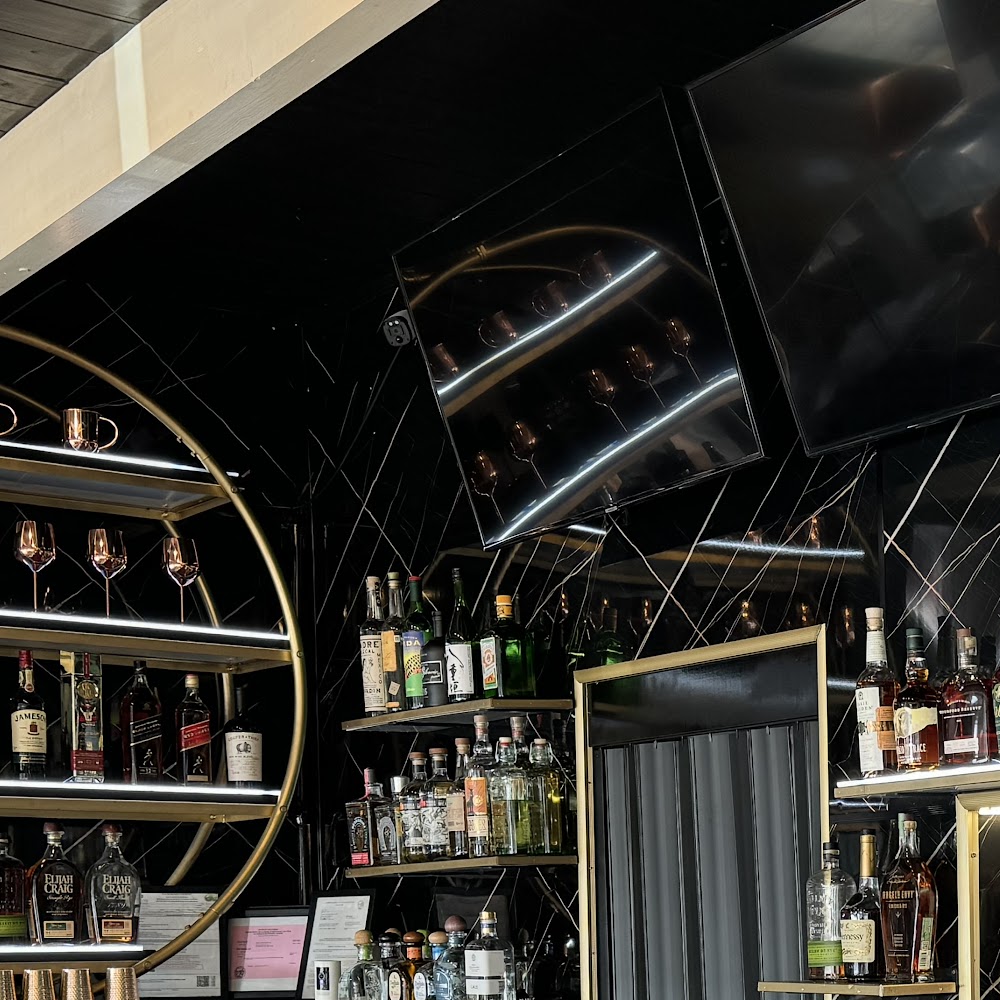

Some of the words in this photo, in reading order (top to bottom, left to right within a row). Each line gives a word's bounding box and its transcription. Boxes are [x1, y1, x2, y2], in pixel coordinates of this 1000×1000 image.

[44, 873, 74, 884] ELIJAH
[102, 873, 131, 884] ELIJAH
[44, 882, 74, 894] CRAIG
[102, 882, 131, 894] CRAIG
